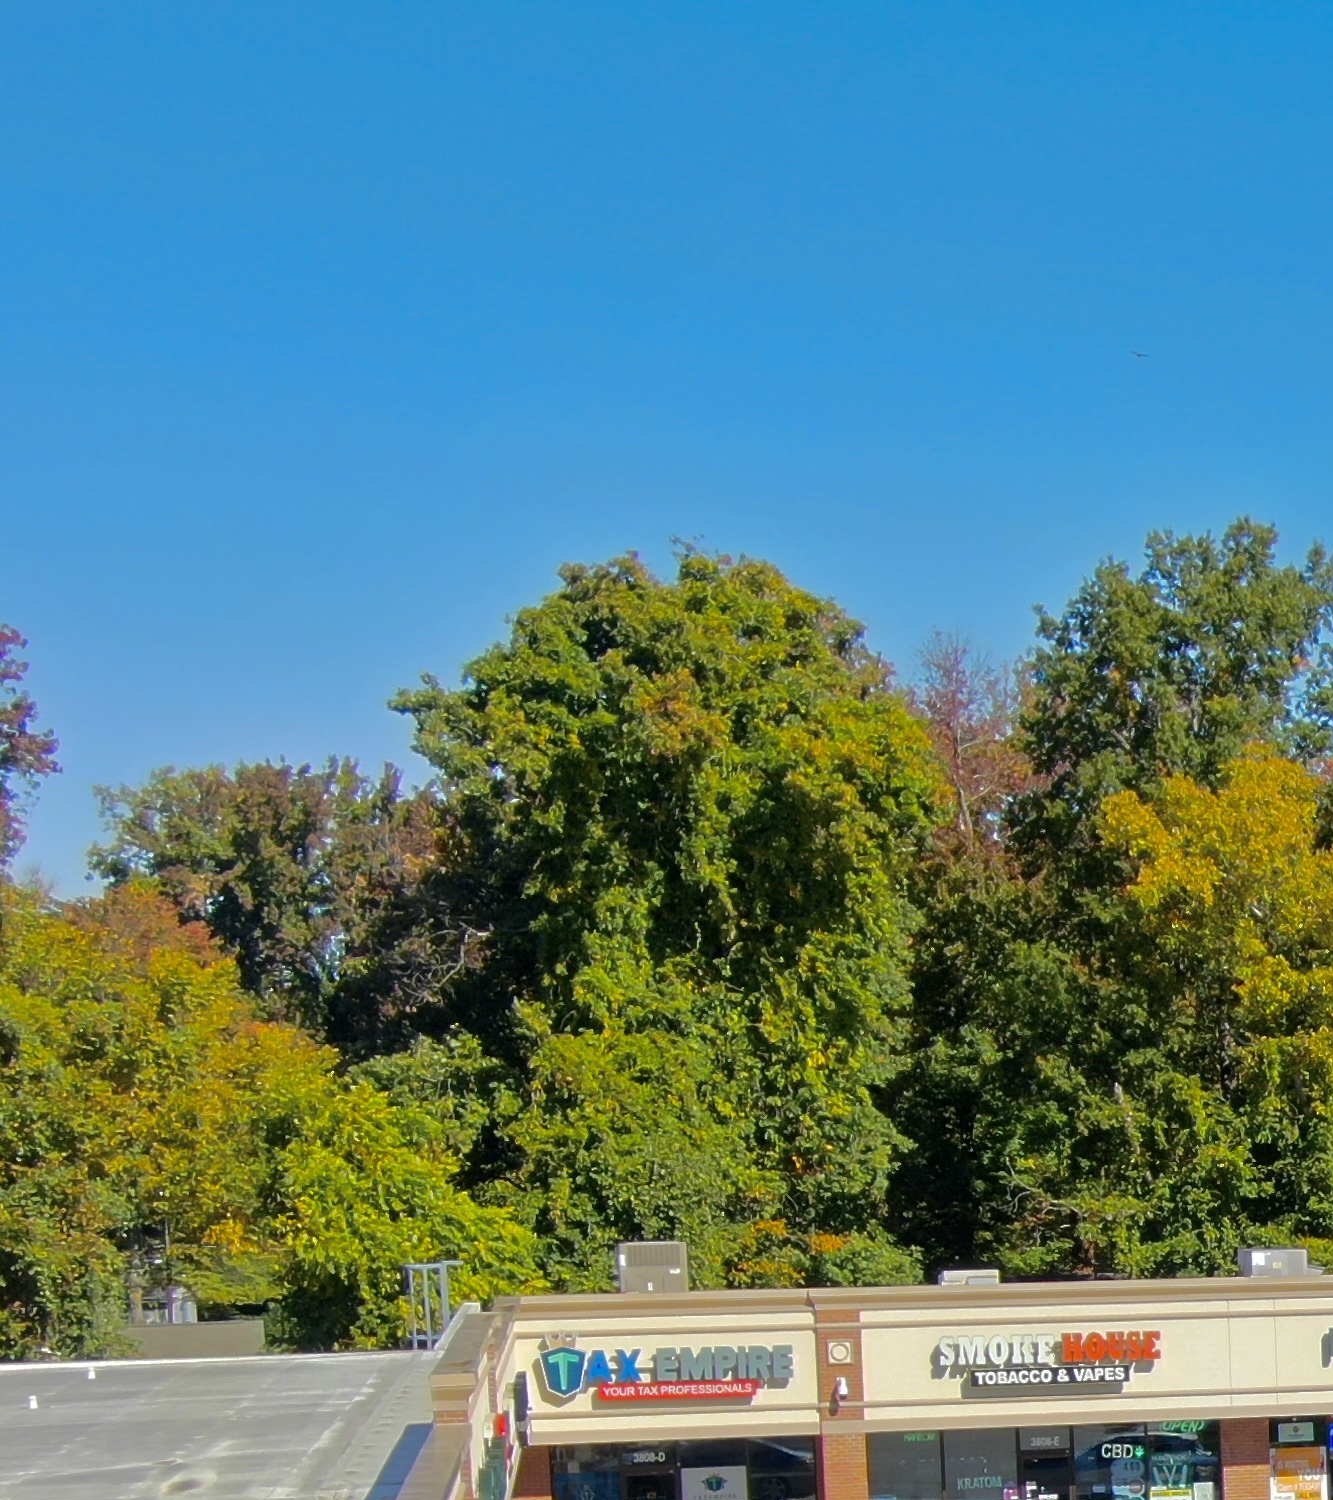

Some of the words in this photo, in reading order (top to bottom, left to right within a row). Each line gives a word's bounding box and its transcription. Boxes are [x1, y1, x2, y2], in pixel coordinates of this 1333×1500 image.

[939, 1334, 1055, 1366] SMOKE
[1061, 1331, 1161, 1363] HOUSE
[655, 1344, 794, 1381] EMPIRE
[974, 1369, 1050, 1385] TOBACCO
[1057, 1369, 1070, 1382] &
[1073, 1367, 1125, 1382] VAPES
[603, 1386, 635, 1396] YOUR
[637, 1385, 659, 1395] TAX
[660, 1383, 752, 1395] PROFESSIONALS
[1101, 1444, 1133, 1458] CBD
[957, 1476, 1002, 1490] KRATOM
